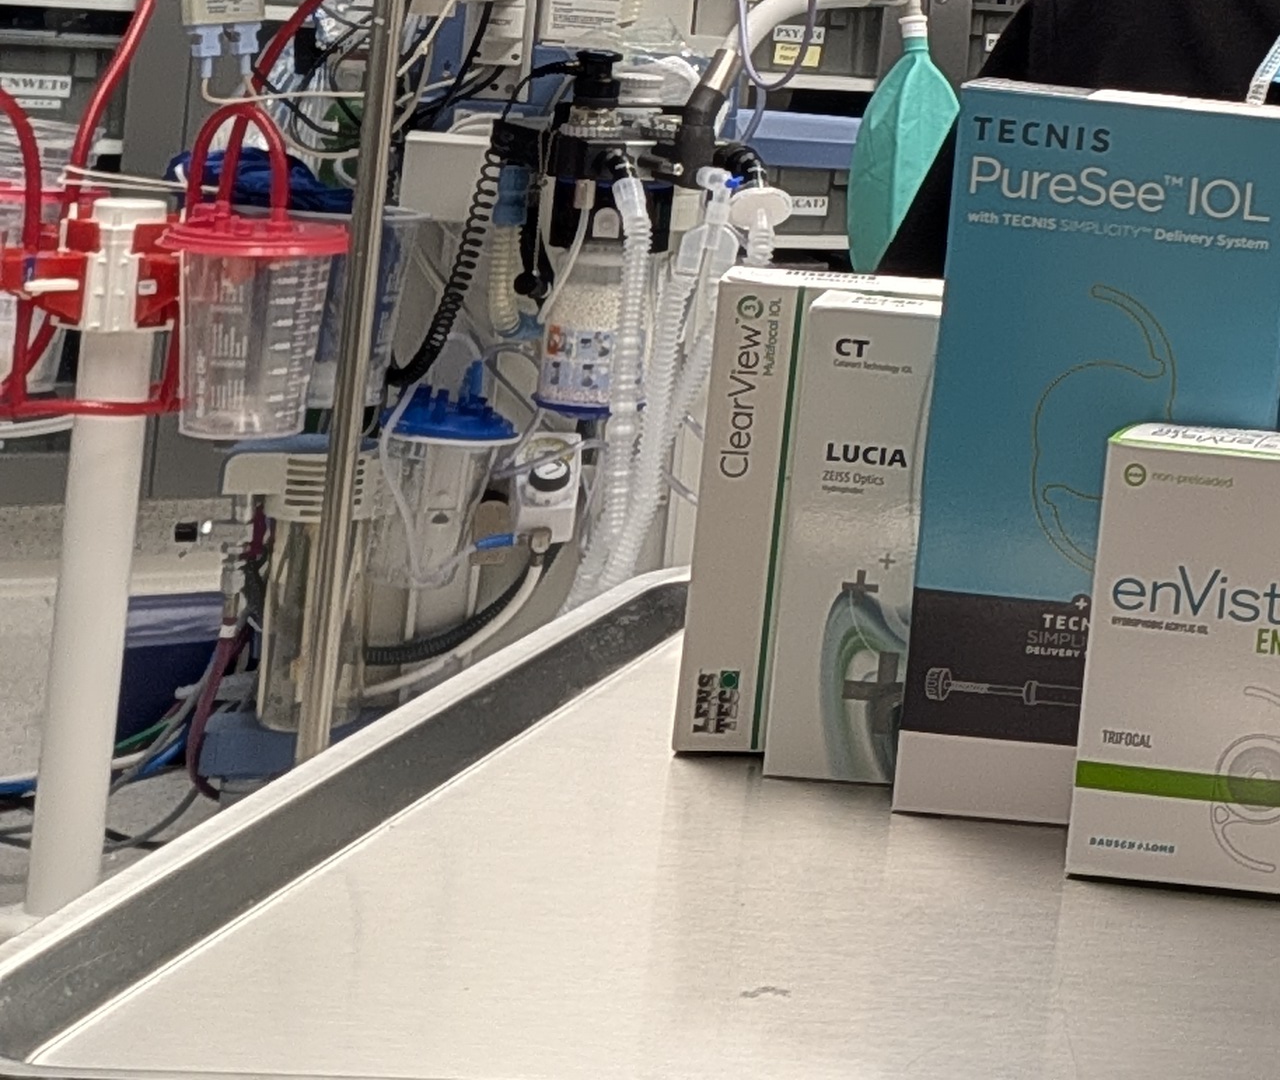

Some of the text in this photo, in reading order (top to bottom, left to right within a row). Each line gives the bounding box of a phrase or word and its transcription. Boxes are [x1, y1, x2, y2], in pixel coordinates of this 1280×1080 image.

[973, 116, 1112, 153] TECNIS
[1188, 177, 1270, 223] IOL
[967, 211, 999, 226] with
[1002, 213, 1057, 231] TECNIS
[1154, 228, 1214, 248] Delivery
[1216, 233, 1271, 252] System
[769, 297, 782, 318] IOL
[835, 338, 870, 359] CT
[825, 442, 908, 469] LUCIA
[822, 470, 886, 487] ZEISS Optics
[1151, 471, 1234, 488] non-preloaded
[1042, 613, 1091, 631] TECN
[1027, 629, 1087, 648] SIMPLI
[1025, 645, 1081, 658] DELIVERY
[1102, 729, 1152, 749] TRIFOCAL
